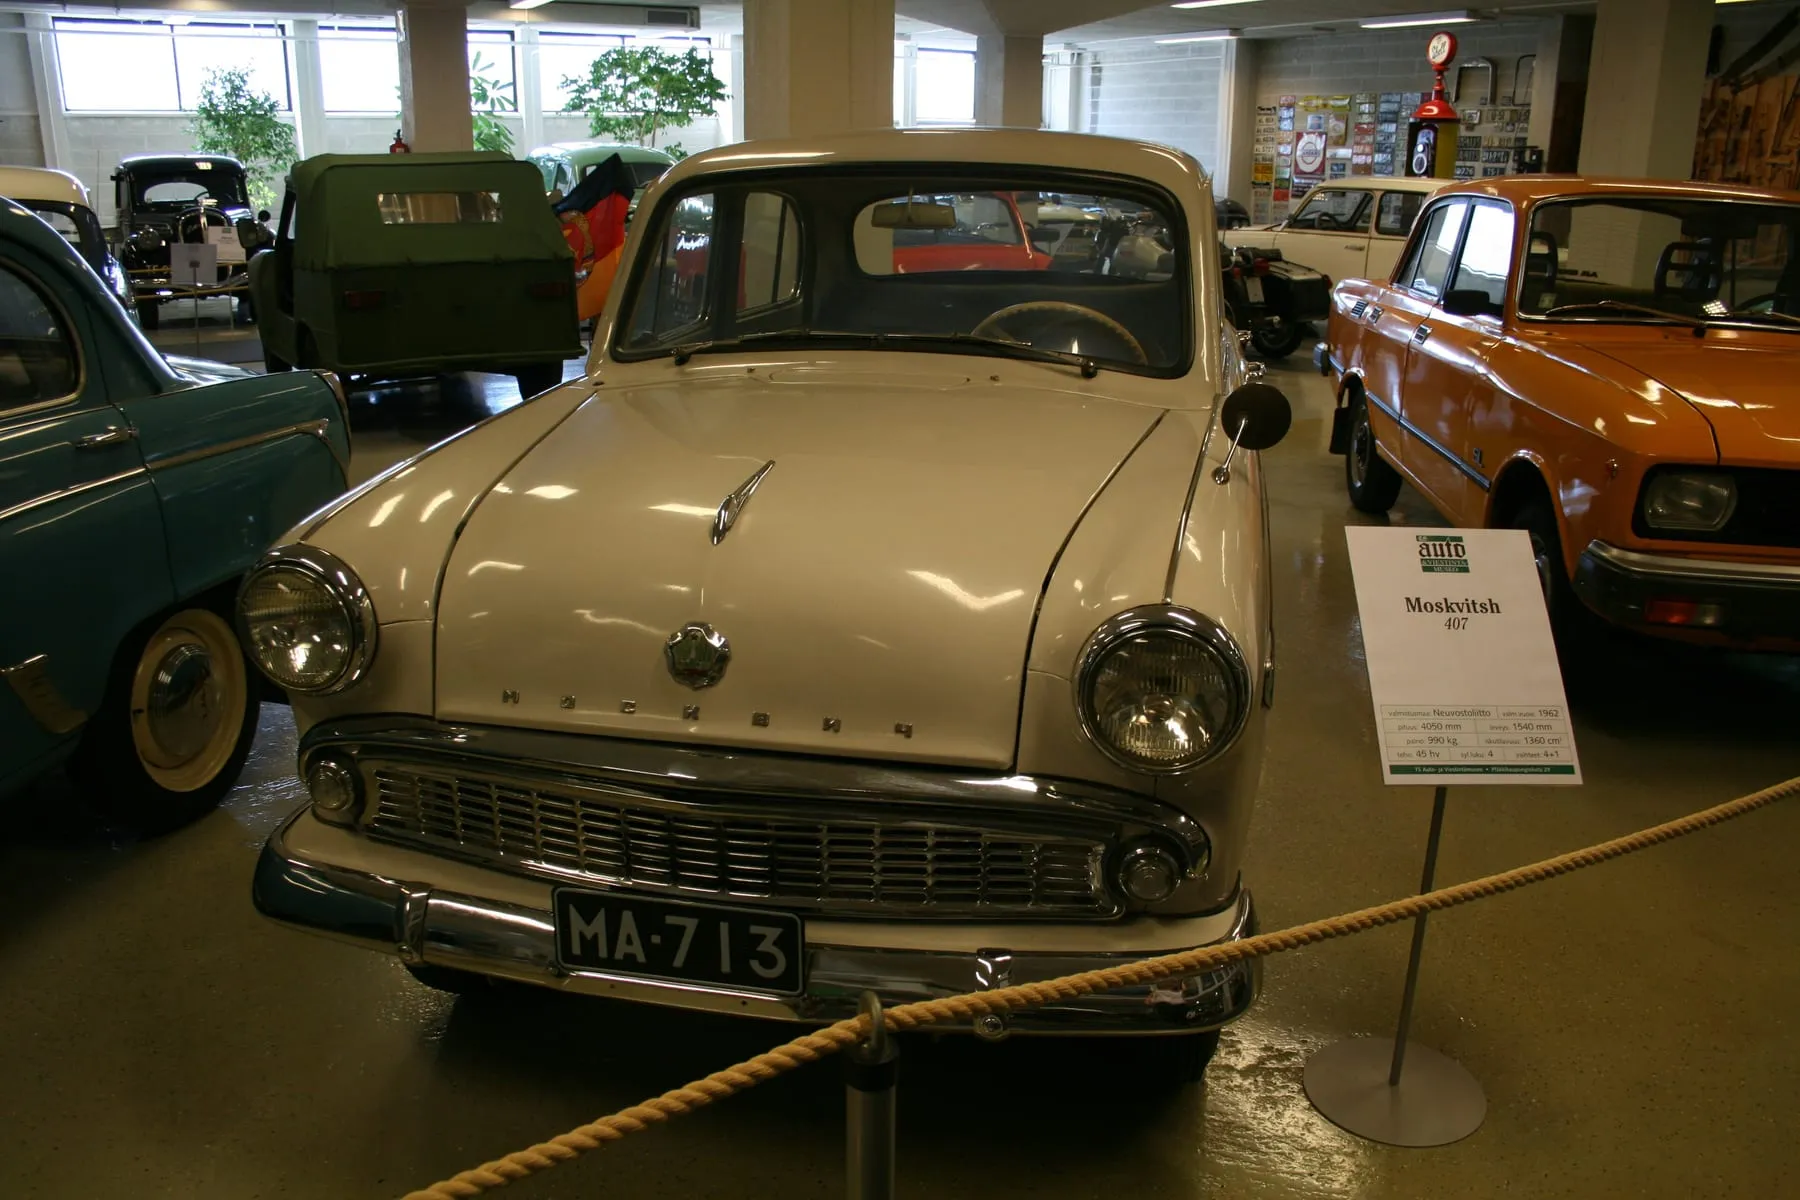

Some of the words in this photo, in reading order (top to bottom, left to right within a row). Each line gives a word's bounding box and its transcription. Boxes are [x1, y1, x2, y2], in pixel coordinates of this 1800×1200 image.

[1418, 540, 1467, 558] auto
[1405, 597, 1502, 614] Moskvitsh
[1444, 617, 1469, 630] 407
[1433, 708, 1492, 717] Neuvostoliitto
[1538, 709, 1559, 718] 1962
[1420, 722, 1443, 731] 4050
[1445, 723, 1462, 731] mm
[1512, 722, 1534, 731] 1540
[1536, 723, 1553, 731] mm
[1427, 736, 1445, 745] 990
[1446, 735, 1458, 746] kg
[1524, 736, 1546, 745] 1360
[1415, 749, 1427, 758] 45
[1428, 749, 1440, 758] hv
[1487, 749, 1494, 758] 4
[1543, 749, 1560, 758] 4+1
[568, 903, 788, 979] MA-713
